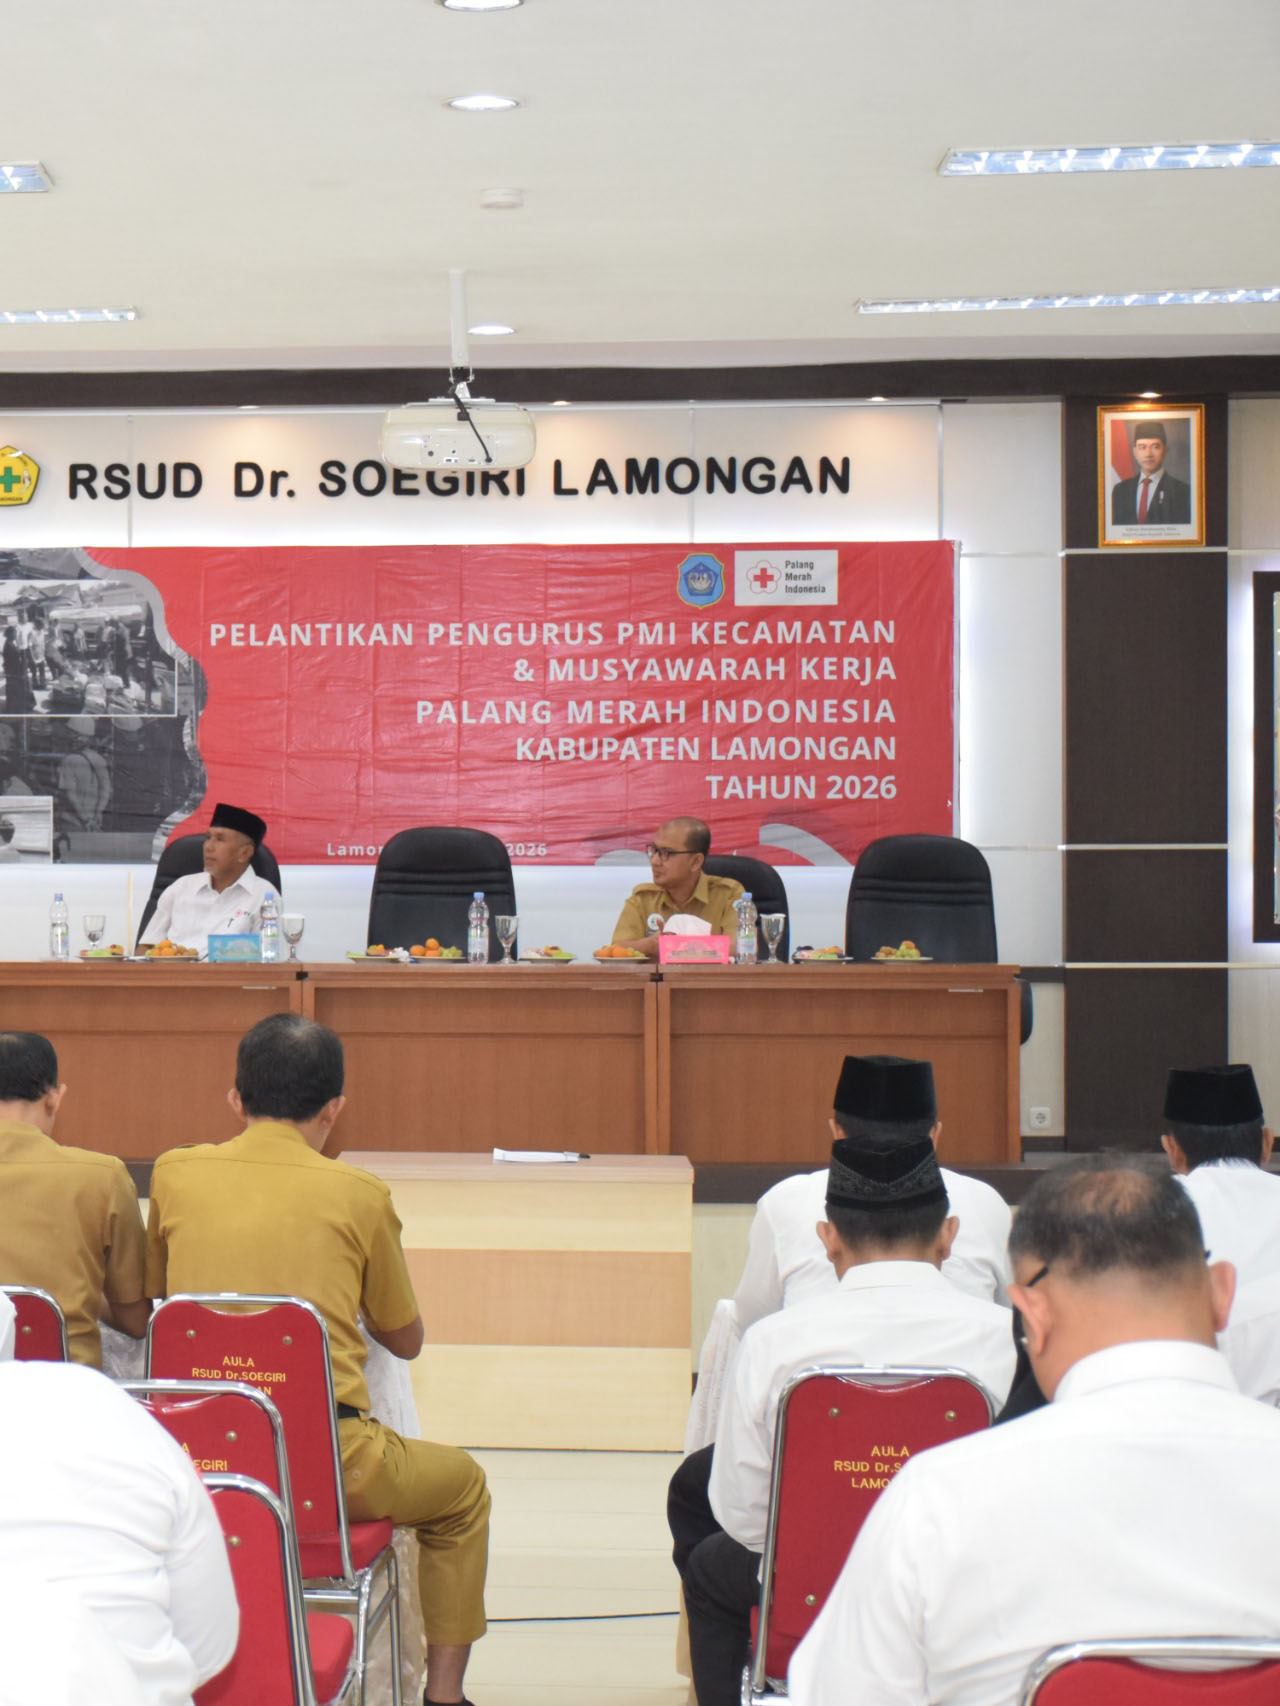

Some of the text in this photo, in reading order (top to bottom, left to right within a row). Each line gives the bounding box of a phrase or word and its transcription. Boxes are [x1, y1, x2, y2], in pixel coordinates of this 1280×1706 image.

[68, 456, 850, 500] RSUD Dr. SOEGIRI LAMONGAN
[785, 560, 814, 571] Palang
[785, 572, 812, 581] Merah
[785, 585, 826, 593] Indonesia
[210, 620, 895, 646] PELANTIKAN PENGURUS PMI KECAMATAN
[513, 657, 897, 686] & MUSYAWARAH KERJA
[416, 699, 896, 724] PALANG MERAH INDONESIA
[517, 736, 896, 761] KABUPATEN LAMONGAN
[705, 775, 897, 800] TAHUN 2026
[327, 843, 383, 857] Lamo
[222, 1355, 255, 1368] AULA
[191, 1367, 286, 1383] RSUD Dr.SOEGIRI
[871, 1445, 910, 1457] AULA
[833, 1460, 870, 1472] RSUD
[851, 1478, 890, 1489] LAMO
